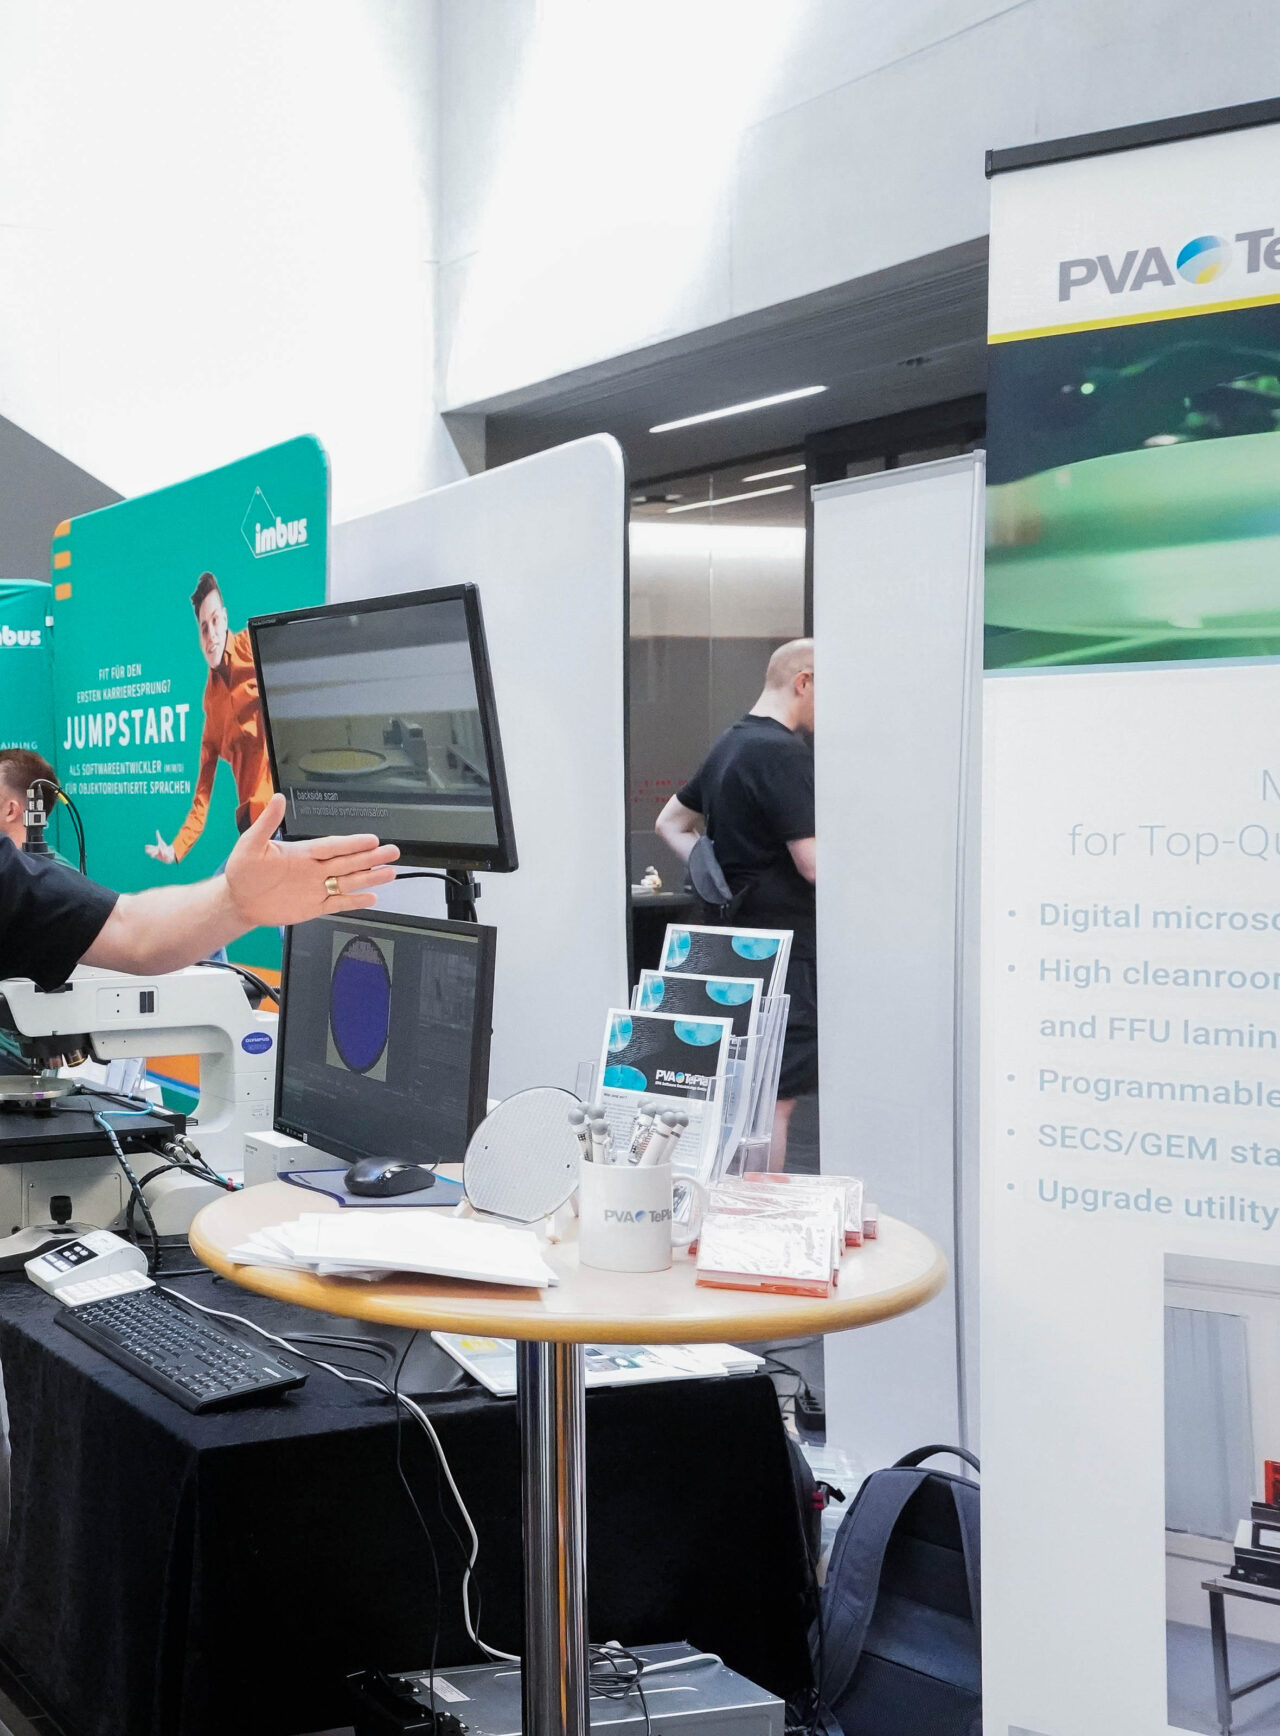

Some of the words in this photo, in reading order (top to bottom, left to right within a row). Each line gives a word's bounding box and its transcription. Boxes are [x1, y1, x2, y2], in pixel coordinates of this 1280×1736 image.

[1058, 246, 1176, 303] PVA
[1234, 227, 1280, 274] Te
[255, 516, 307, 554] imbus
[98, 668, 109, 681] FIT
[111, 664, 125, 680] FÜR
[126, 663, 142, 678] DEN
[77, 689, 102, 704] ERSTEN
[103, 679, 172, 700] KARRIERESPRUNG?
[63, 703, 190, 751] JUMPSTART
[150, 780, 191, 794] SPRACHEN
[297, 790, 323, 801] backside
[324, 792, 339, 801] scan
[1069, 824, 1126, 857] for
[1140, 824, 1280, 864] Top-Q
[1039, 903, 1141, 933] Digital
[1039, 957, 1111, 989] High
[1039, 1015, 1097, 1039] and
[1108, 1017, 1171, 1044] FFU
[1183, 1019, 1279, 1049] lamin
[655, 1069, 676, 1082] PVA
[684, 1072, 709, 1087] TePla
[1038, 1125, 1217, 1161] SECS/GEM
[1230, 1142, 1280, 1167] sta
[604, 1209, 635, 1223] PVA
[1037, 1179, 1173, 1213] Upgrade
[1184, 1196, 1280, 1230] utility
